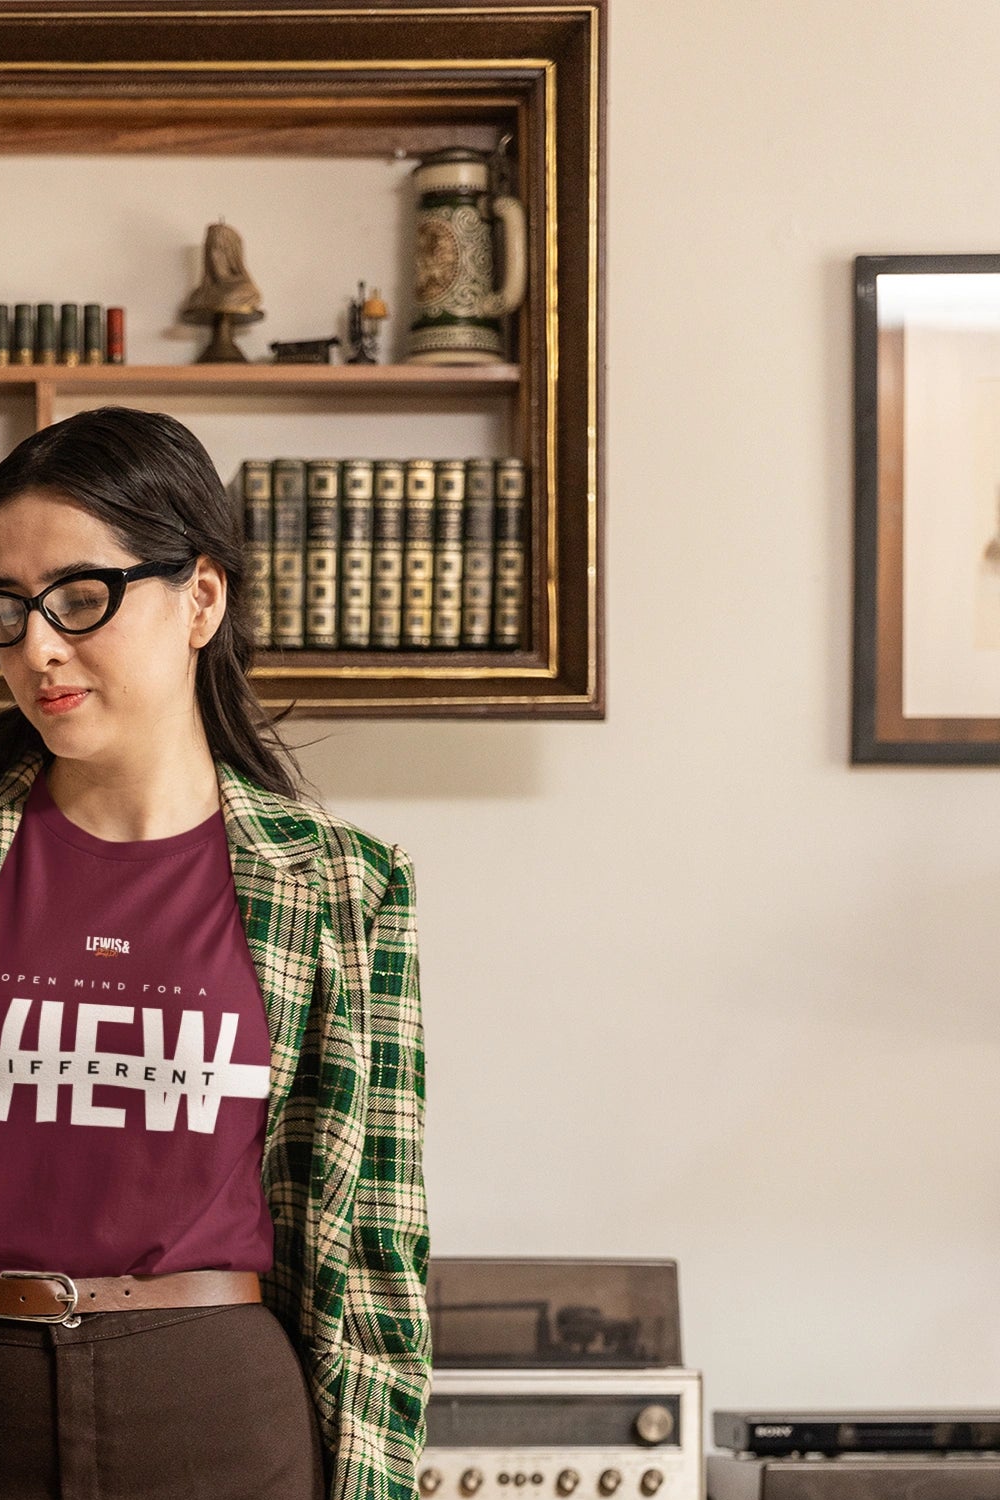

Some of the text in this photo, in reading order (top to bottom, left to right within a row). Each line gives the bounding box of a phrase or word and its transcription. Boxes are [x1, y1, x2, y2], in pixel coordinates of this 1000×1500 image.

[1, 973, 207, 997] OPEN MIND FOR A
